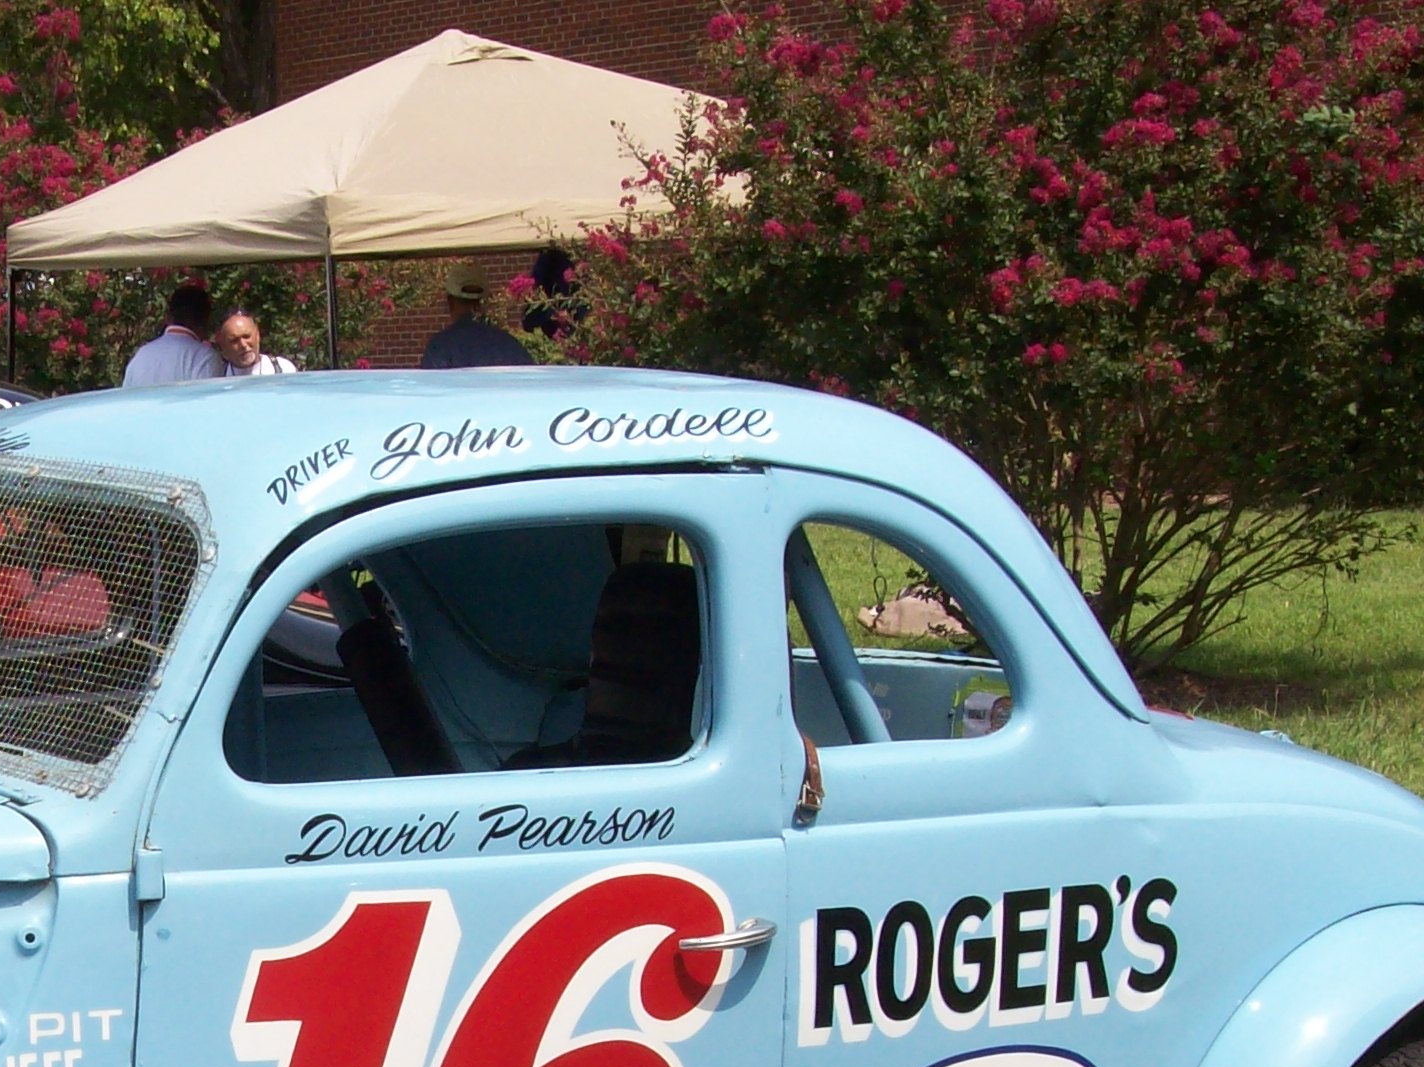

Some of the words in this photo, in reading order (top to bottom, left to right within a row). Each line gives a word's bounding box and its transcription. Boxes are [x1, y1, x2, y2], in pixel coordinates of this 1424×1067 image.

[267, 438, 353, 505] DRIVER
[370, 419, 524, 481] John
[549, 407, 772, 446] Cordell
[285, 811, 459, 864] David
[478, 804, 674, 852] Pearson
[811, 875, 1178, 1032] ROGER'S
[29, 1009, 123, 1045] PIT
